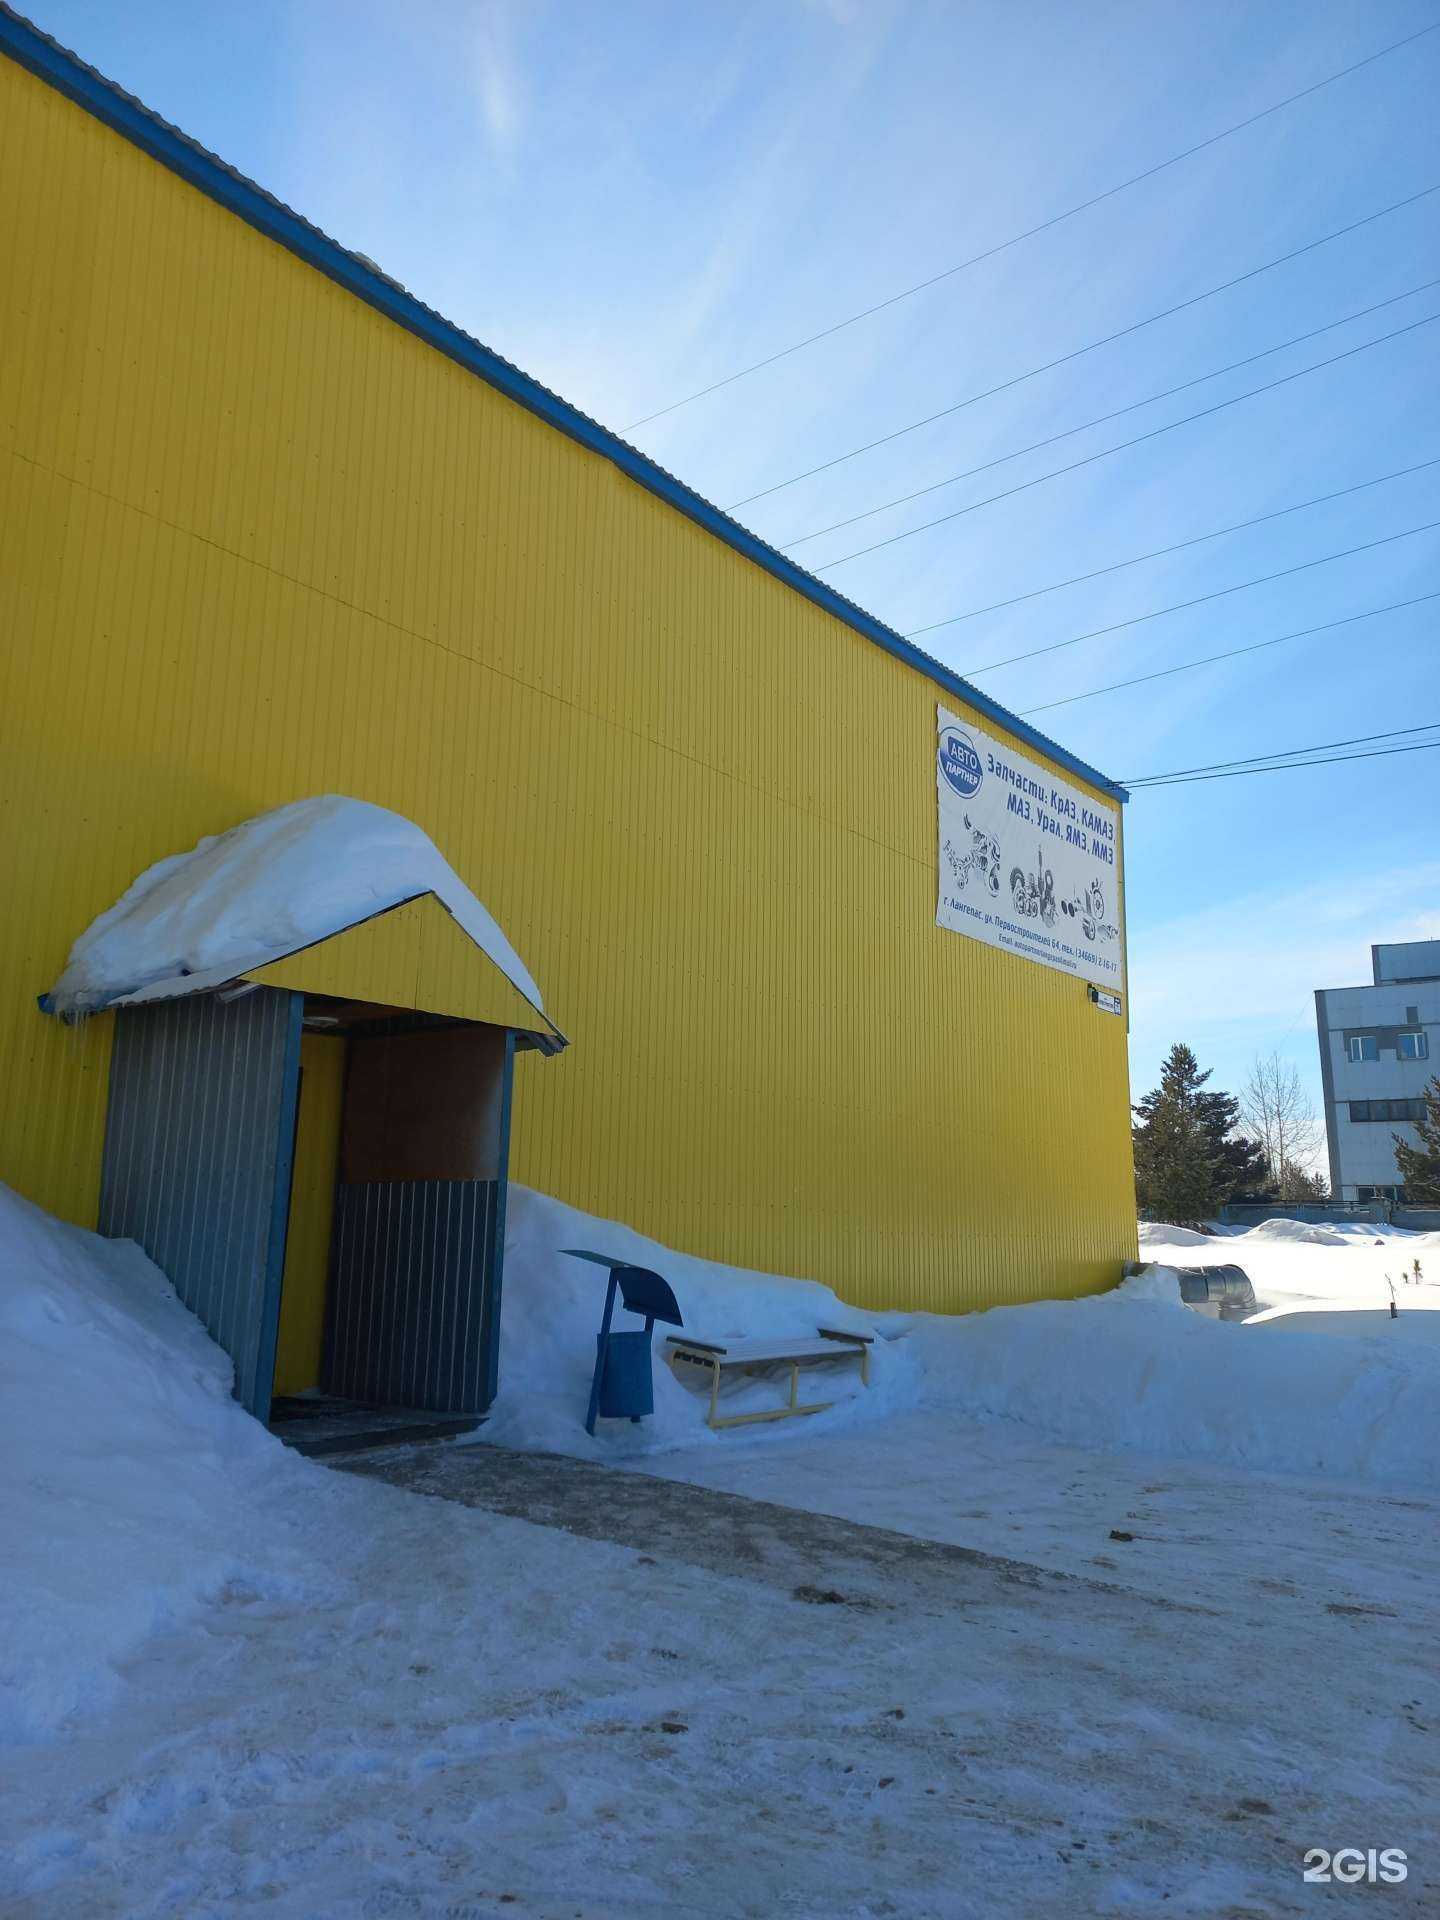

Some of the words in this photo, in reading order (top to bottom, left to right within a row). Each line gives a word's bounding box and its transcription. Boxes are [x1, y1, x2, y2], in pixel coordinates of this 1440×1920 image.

[946, 761, 979, 786] ПАРТНЕР
[950, 743, 978, 769] АВТО
[987, 752, 1048, 804] Запчасти:
[1050, 789, 1079, 824] КрАЗ,
[1007, 791, 1034, 825] МАЗ,
[1036, 807, 1063, 840] Урал,
[1065, 824, 1090, 855] ЯМЗ,
[1091, 838, 1114, 865] ММЗ
